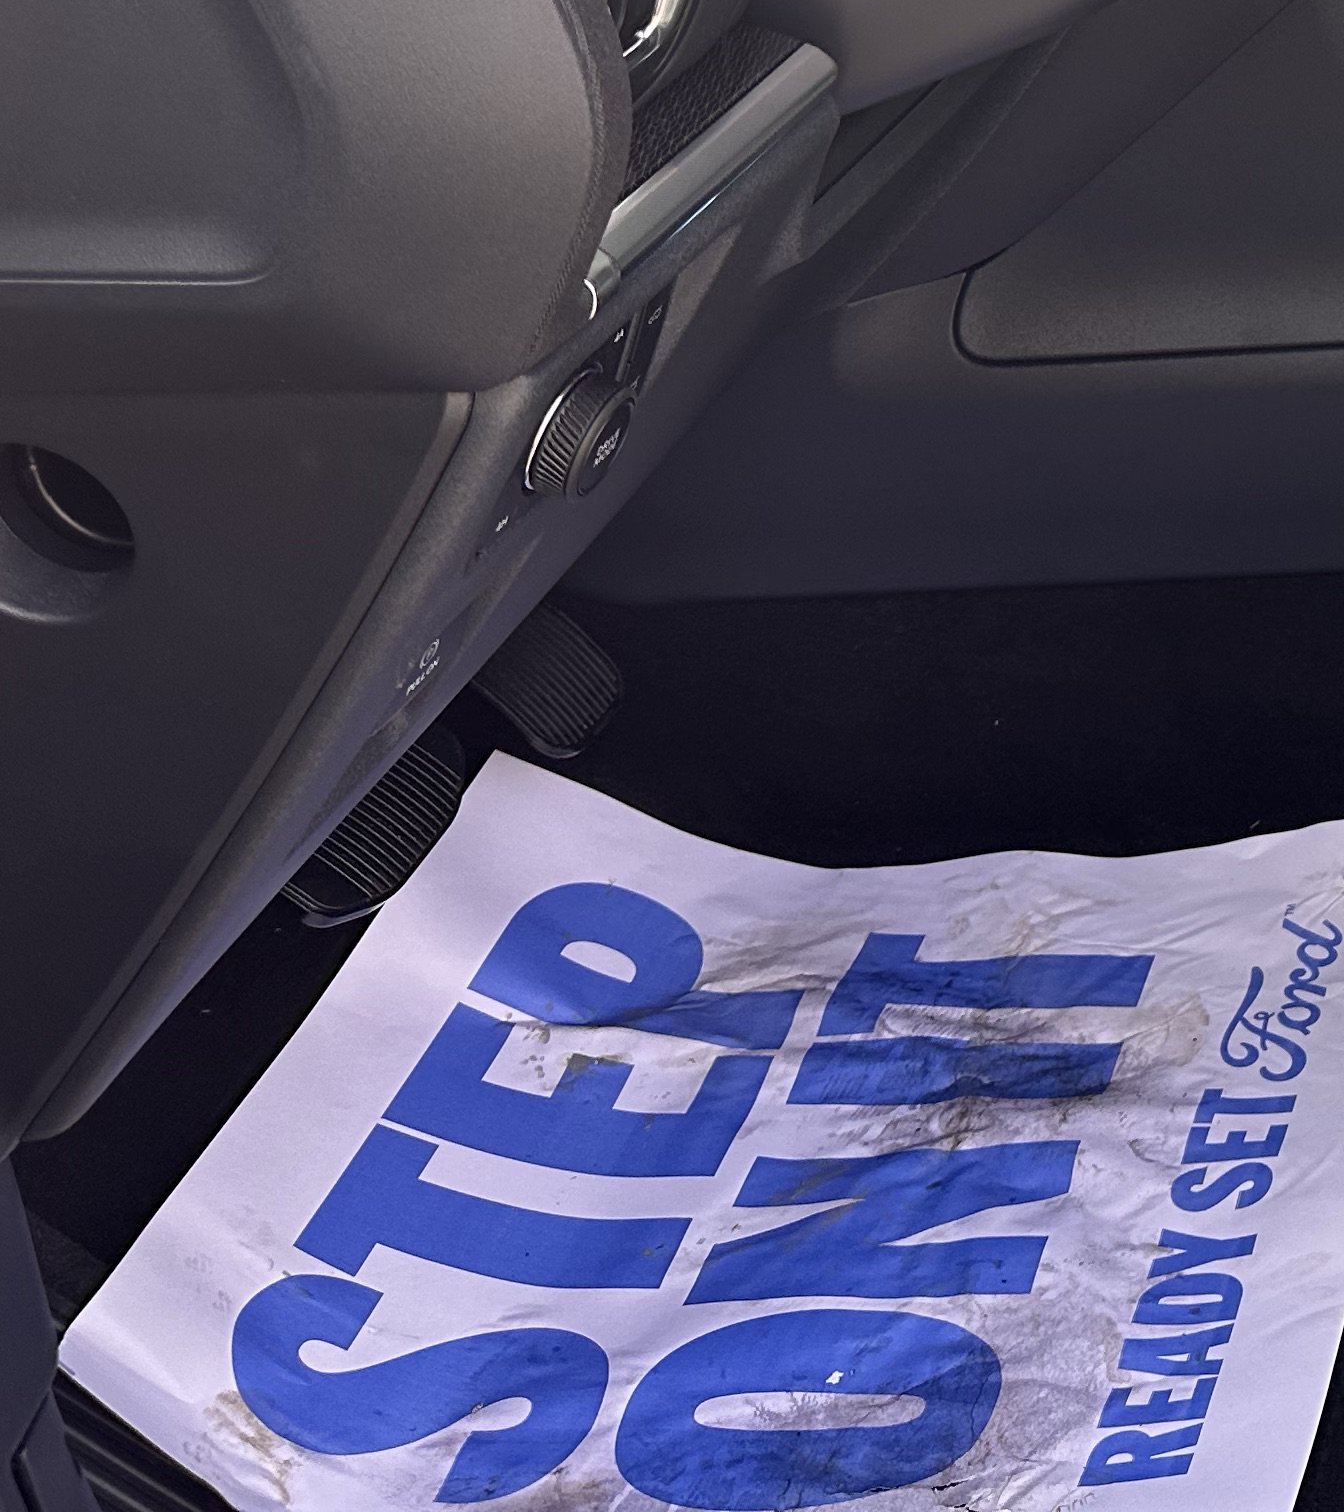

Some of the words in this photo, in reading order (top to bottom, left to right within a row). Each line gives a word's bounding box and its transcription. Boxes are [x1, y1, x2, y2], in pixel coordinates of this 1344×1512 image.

[786, 932, 1156, 1106] IT
[1219, 917, 1344, 1082] Ford
[232, 881, 805, 1502] STEP
[1170, 1088, 1298, 1212] SET
[615, 1139, 1082, 1512] ON
[1077, 1228, 1258, 1488] READY
